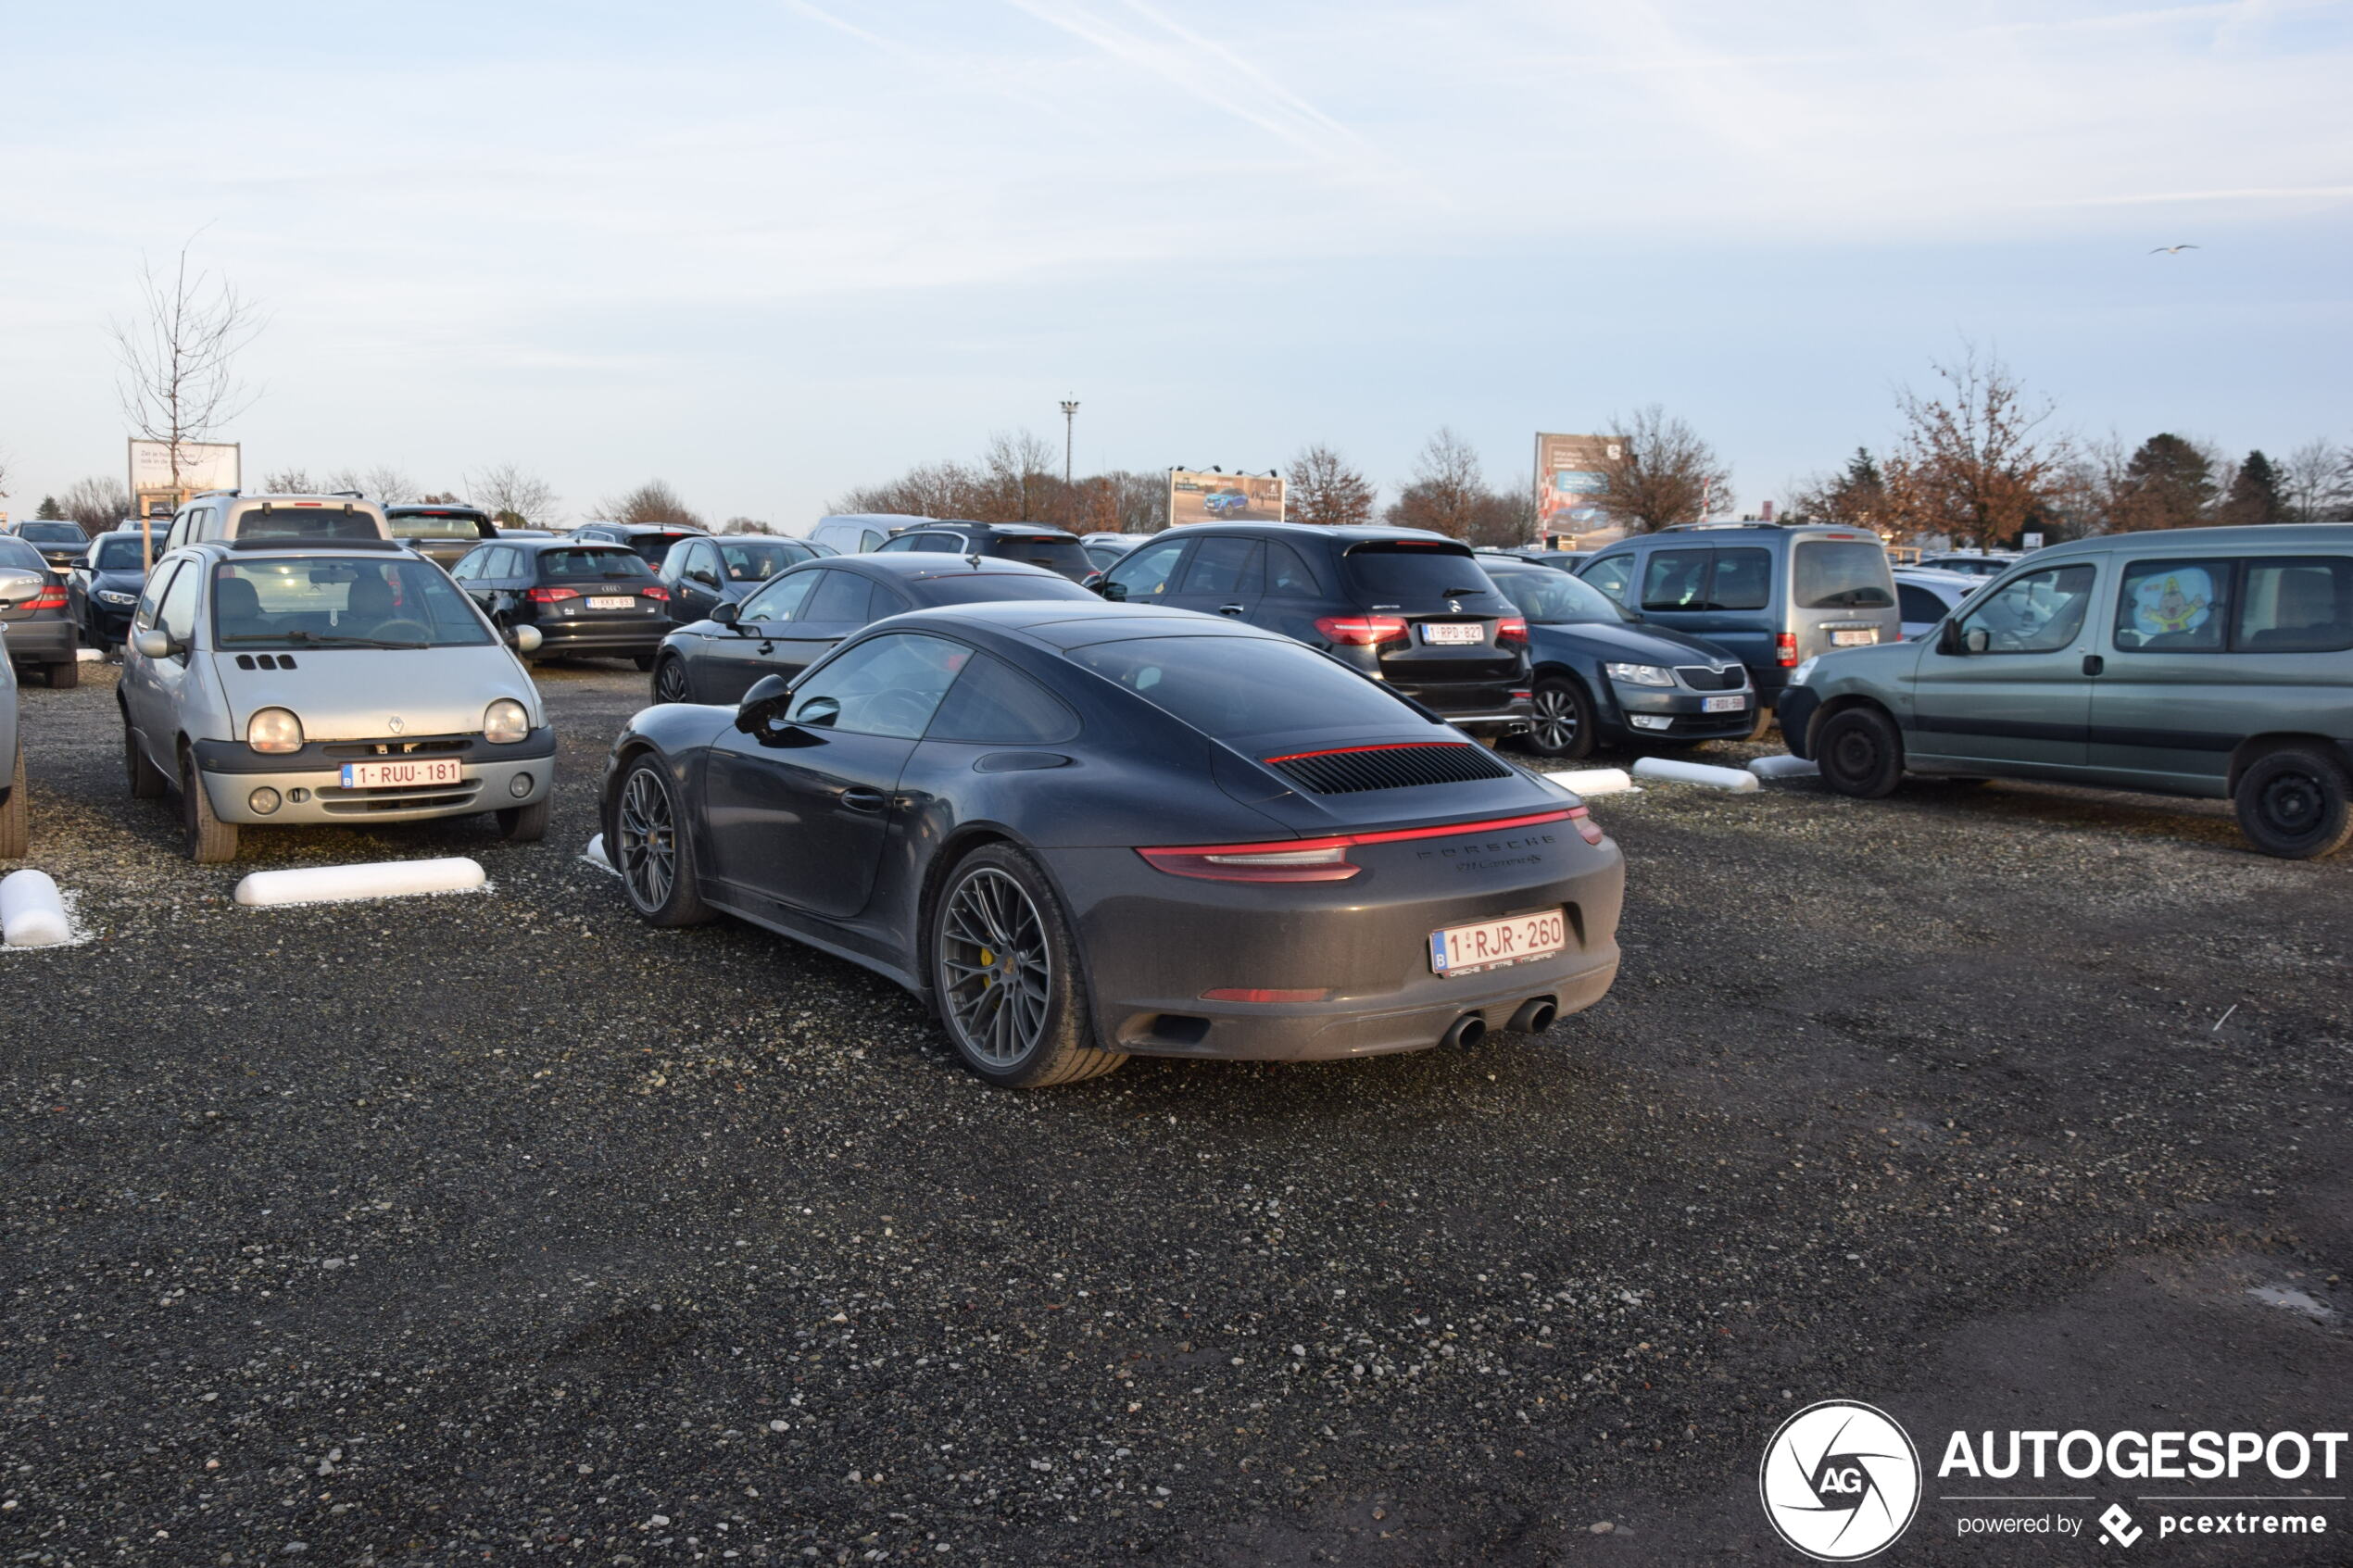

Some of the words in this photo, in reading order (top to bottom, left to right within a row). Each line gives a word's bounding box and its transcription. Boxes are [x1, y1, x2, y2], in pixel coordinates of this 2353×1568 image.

[1429, 626, 1482, 639] 1-RPD-827
[359, 763, 457, 784] 1-RUU-181
[1416, 834, 1557, 860] PORSCHE
[1450, 917, 1562, 962] 1-RJR-260
[1436, 954, 1446, 968] B
